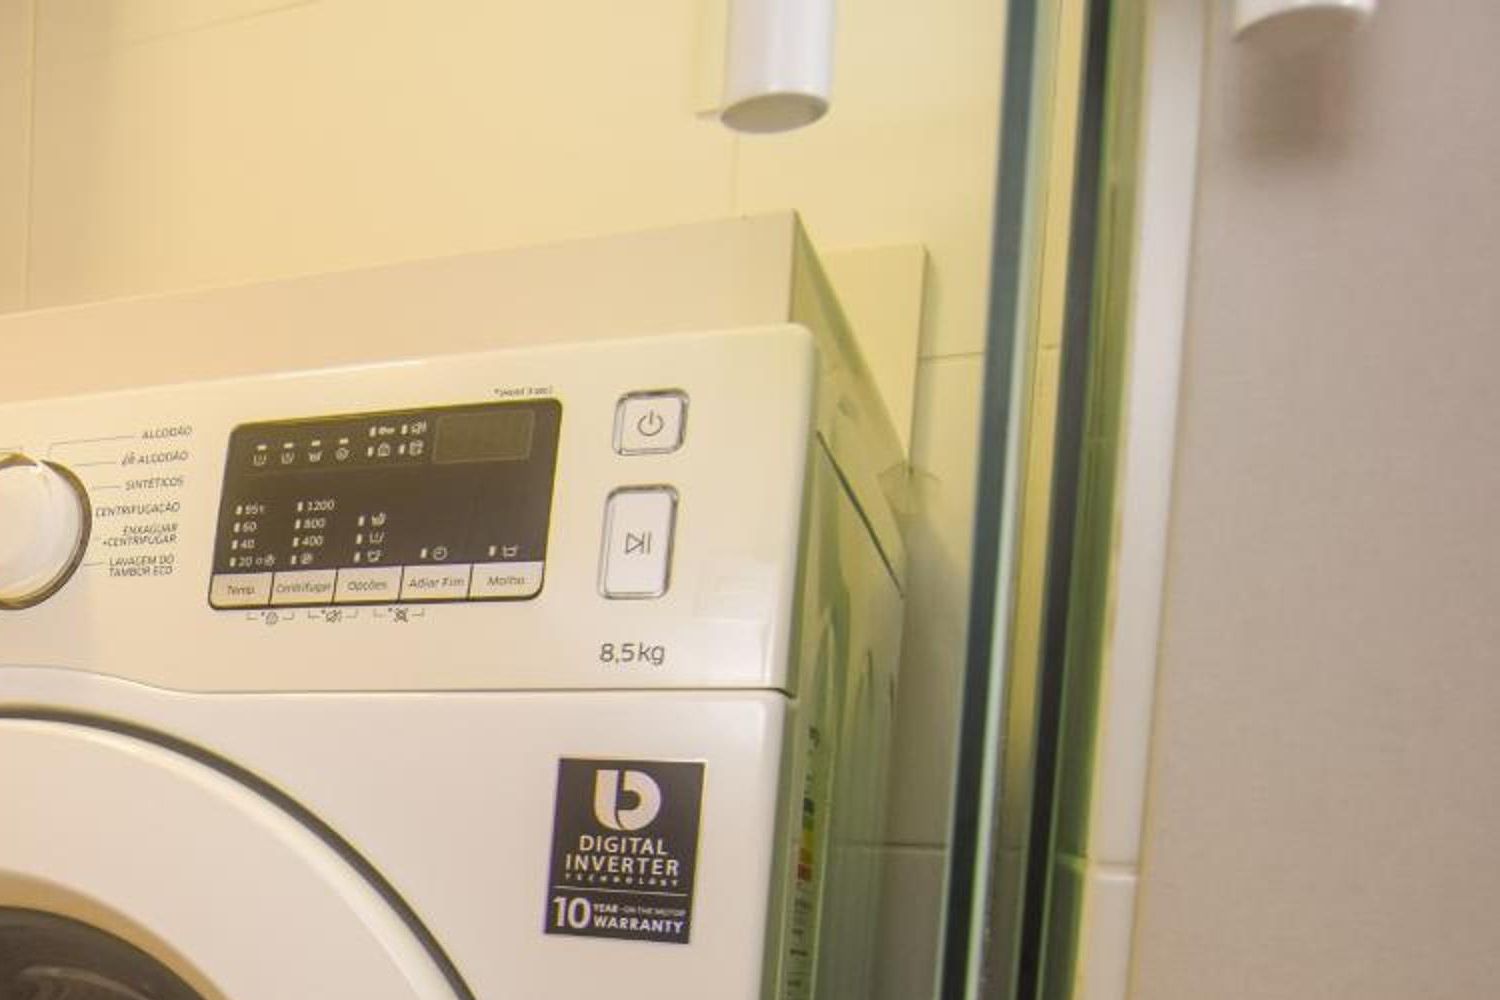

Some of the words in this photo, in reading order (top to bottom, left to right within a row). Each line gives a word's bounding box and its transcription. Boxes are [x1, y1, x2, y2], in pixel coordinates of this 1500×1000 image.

[141, 425, 192, 439] ALGODÃO
[137, 450, 188, 465] ALGODÃO
[307, 500, 335, 511] 1200
[242, 521, 257, 532] 60
[303, 518, 326, 529] 800
[240, 539, 255, 549] 40
[302, 536, 324, 546] 400
[238, 556, 253, 567] 20
[347, 579, 388, 592] Opções
[486, 574, 526, 587] Molho
[579, 834, 668, 855] DIGITAL
[565, 853, 680, 877] INVERTER
[564, 873, 679, 887] TECHNOLOGY
[553, 895, 592, 929] 10
[593, 903, 619, 914] YEAR
[593, 914, 685, 935] WARRANTY
